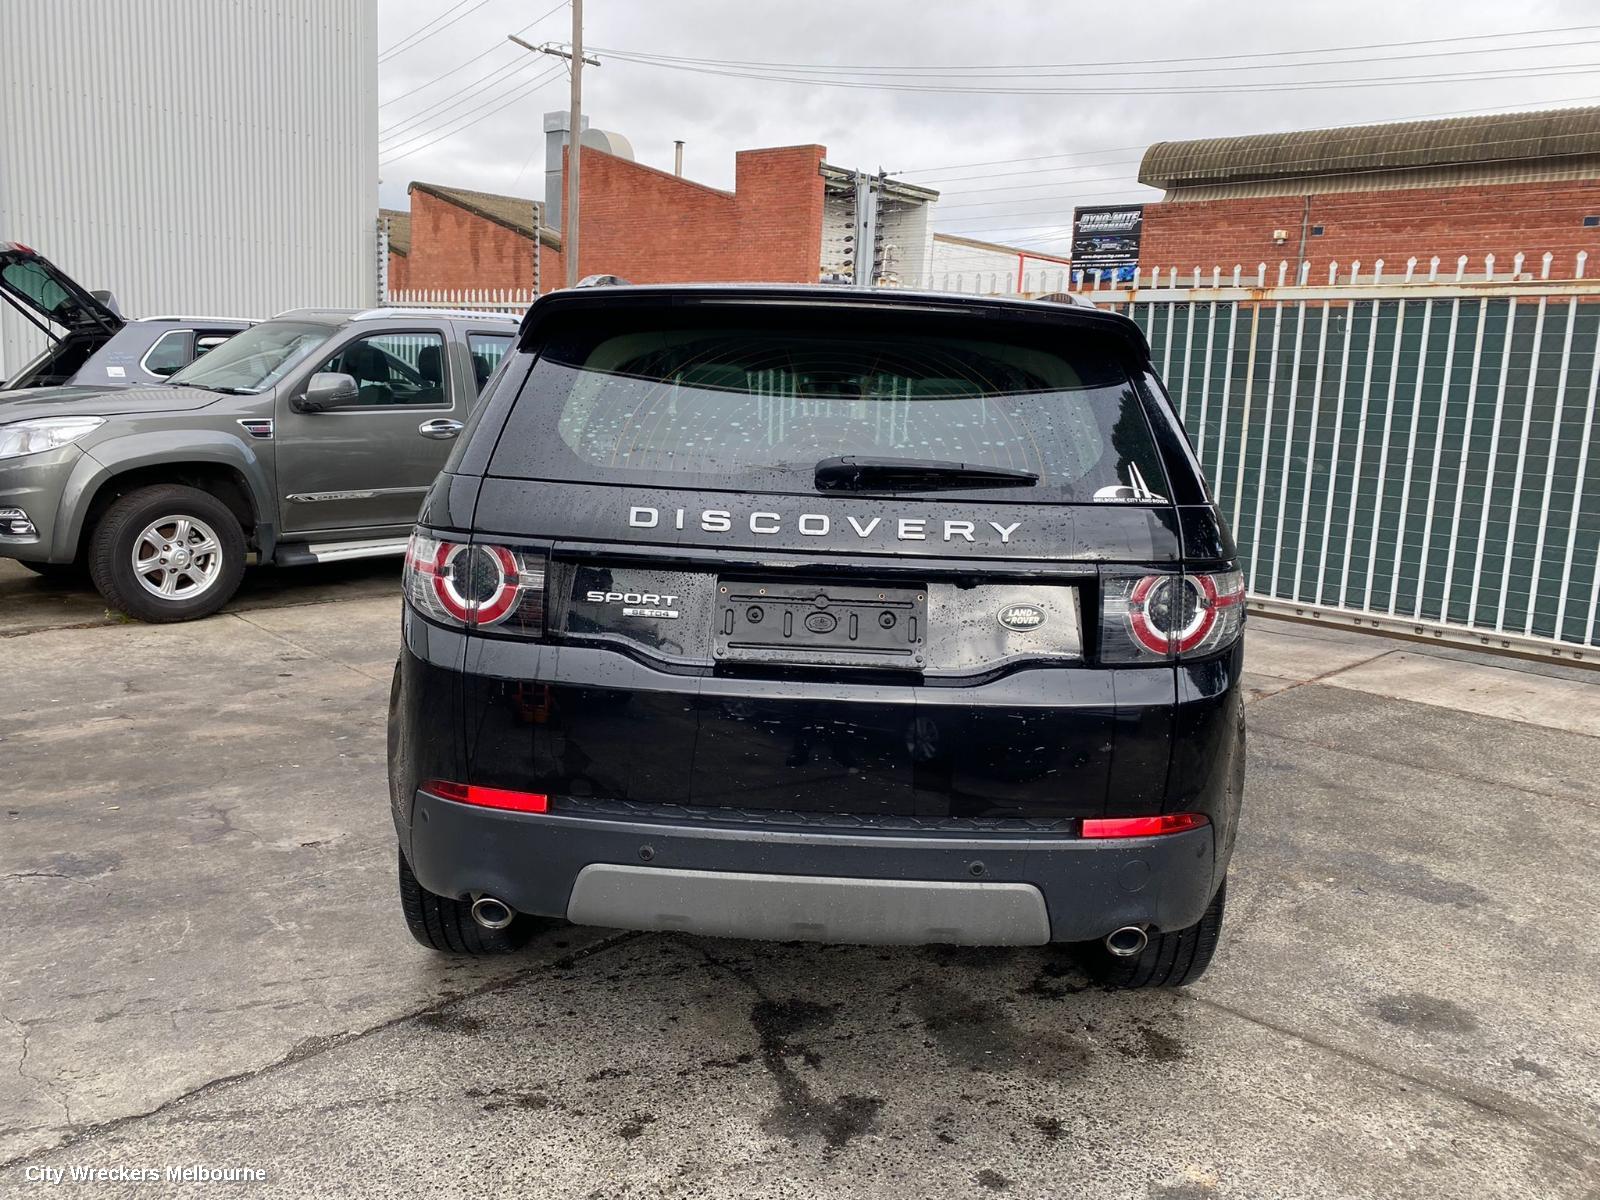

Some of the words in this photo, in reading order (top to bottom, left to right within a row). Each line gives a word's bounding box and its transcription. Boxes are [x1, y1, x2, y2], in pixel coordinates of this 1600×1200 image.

[1080, 212, 1140, 225] DYNO-MITE
[629, 506, 1022, 543] DISCOVERY
[587, 591, 679, 606] SPORT
[1008, 608, 1033, 617] LAND
[1010, 616, 1040, 625] ROVER
